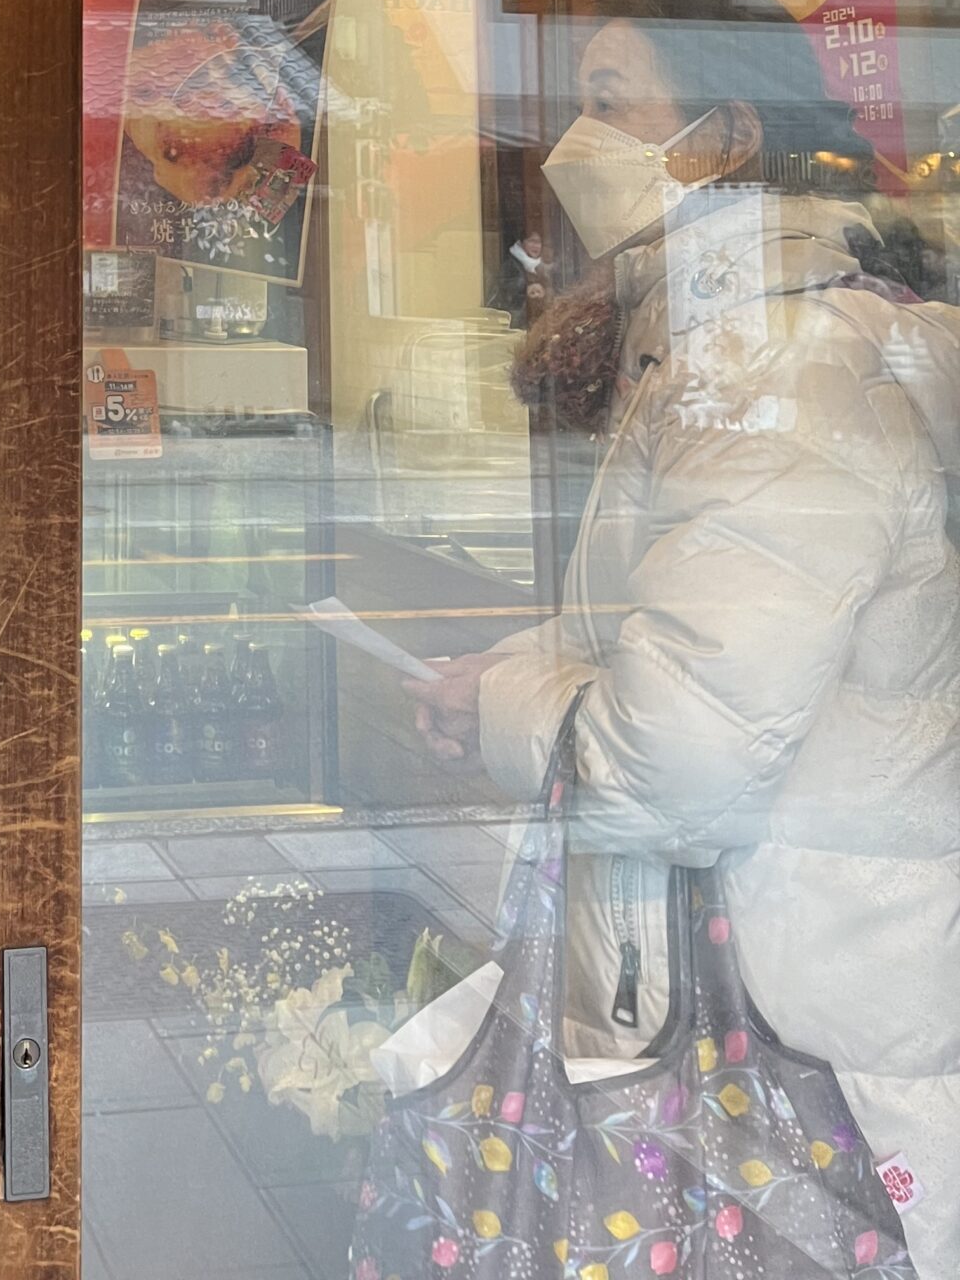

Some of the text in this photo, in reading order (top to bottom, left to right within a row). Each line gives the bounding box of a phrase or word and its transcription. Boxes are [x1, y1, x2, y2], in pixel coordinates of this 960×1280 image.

[823, 6, 855, 24] 2024
[825, 18, 875, 50] 2.10
[849, 50, 877, 77] 12
[853, 83, 883, 102] 10:00
